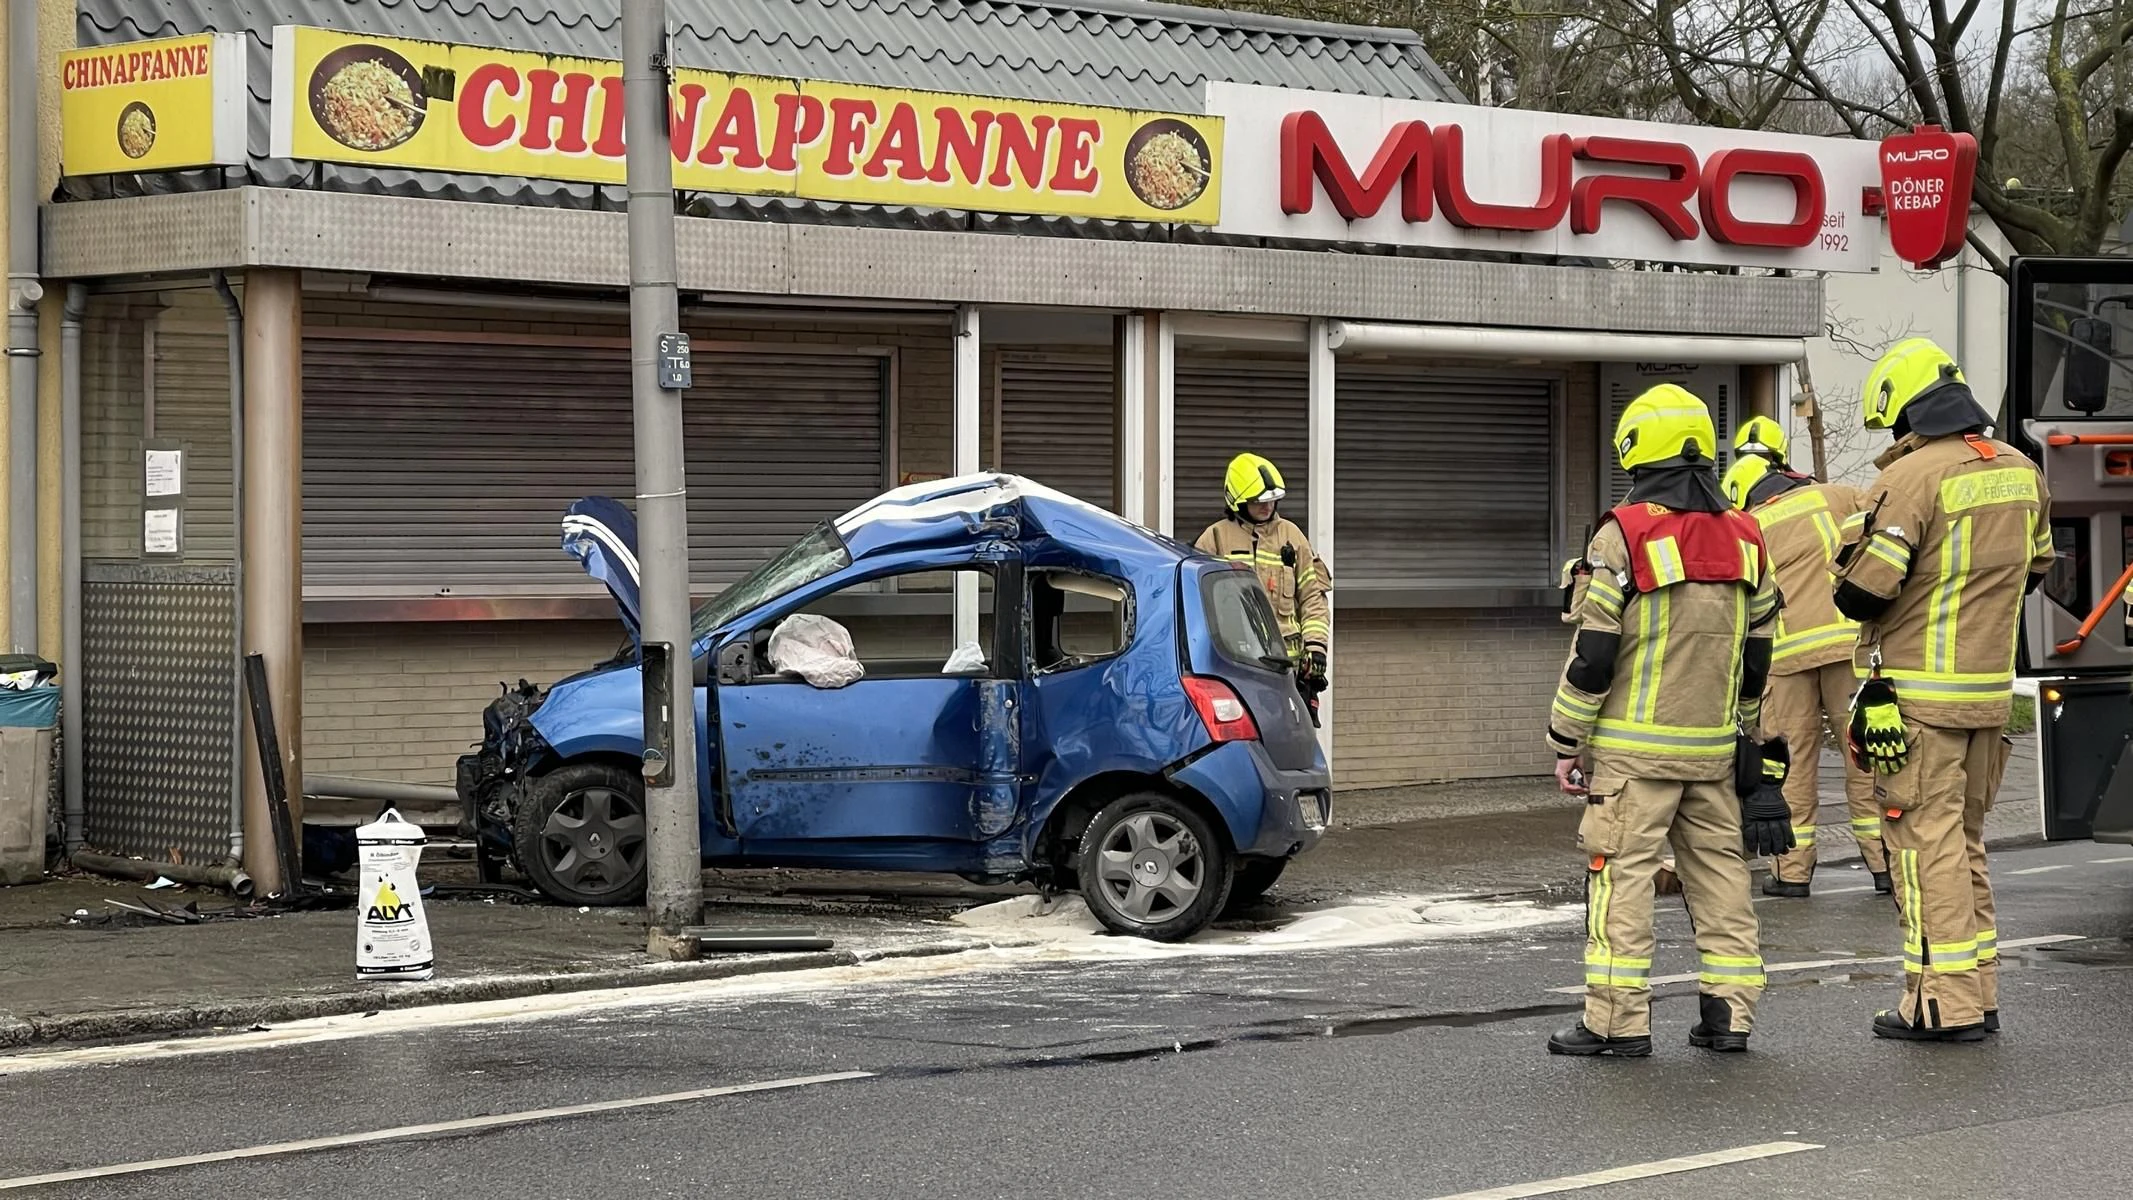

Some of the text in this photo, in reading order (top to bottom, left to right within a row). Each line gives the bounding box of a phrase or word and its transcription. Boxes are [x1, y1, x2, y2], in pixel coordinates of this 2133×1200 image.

[63, 44, 208, 90] CHINAPFANNE
[457, 63, 1101, 193] CHINAPFANNE
[1887, 148, 1949, 163] MURO
[1280, 110, 1827, 248] MURO
[1891, 177, 1944, 195] DÖNER
[1895, 194, 1942, 210] KEBAP
[1822, 211, 1846, 229] seit
[1820, 233, 1849, 252] 1992
[660, 340, 690, 354] S 250
[1984, 484, 2034, 499] FEUERWEHR
